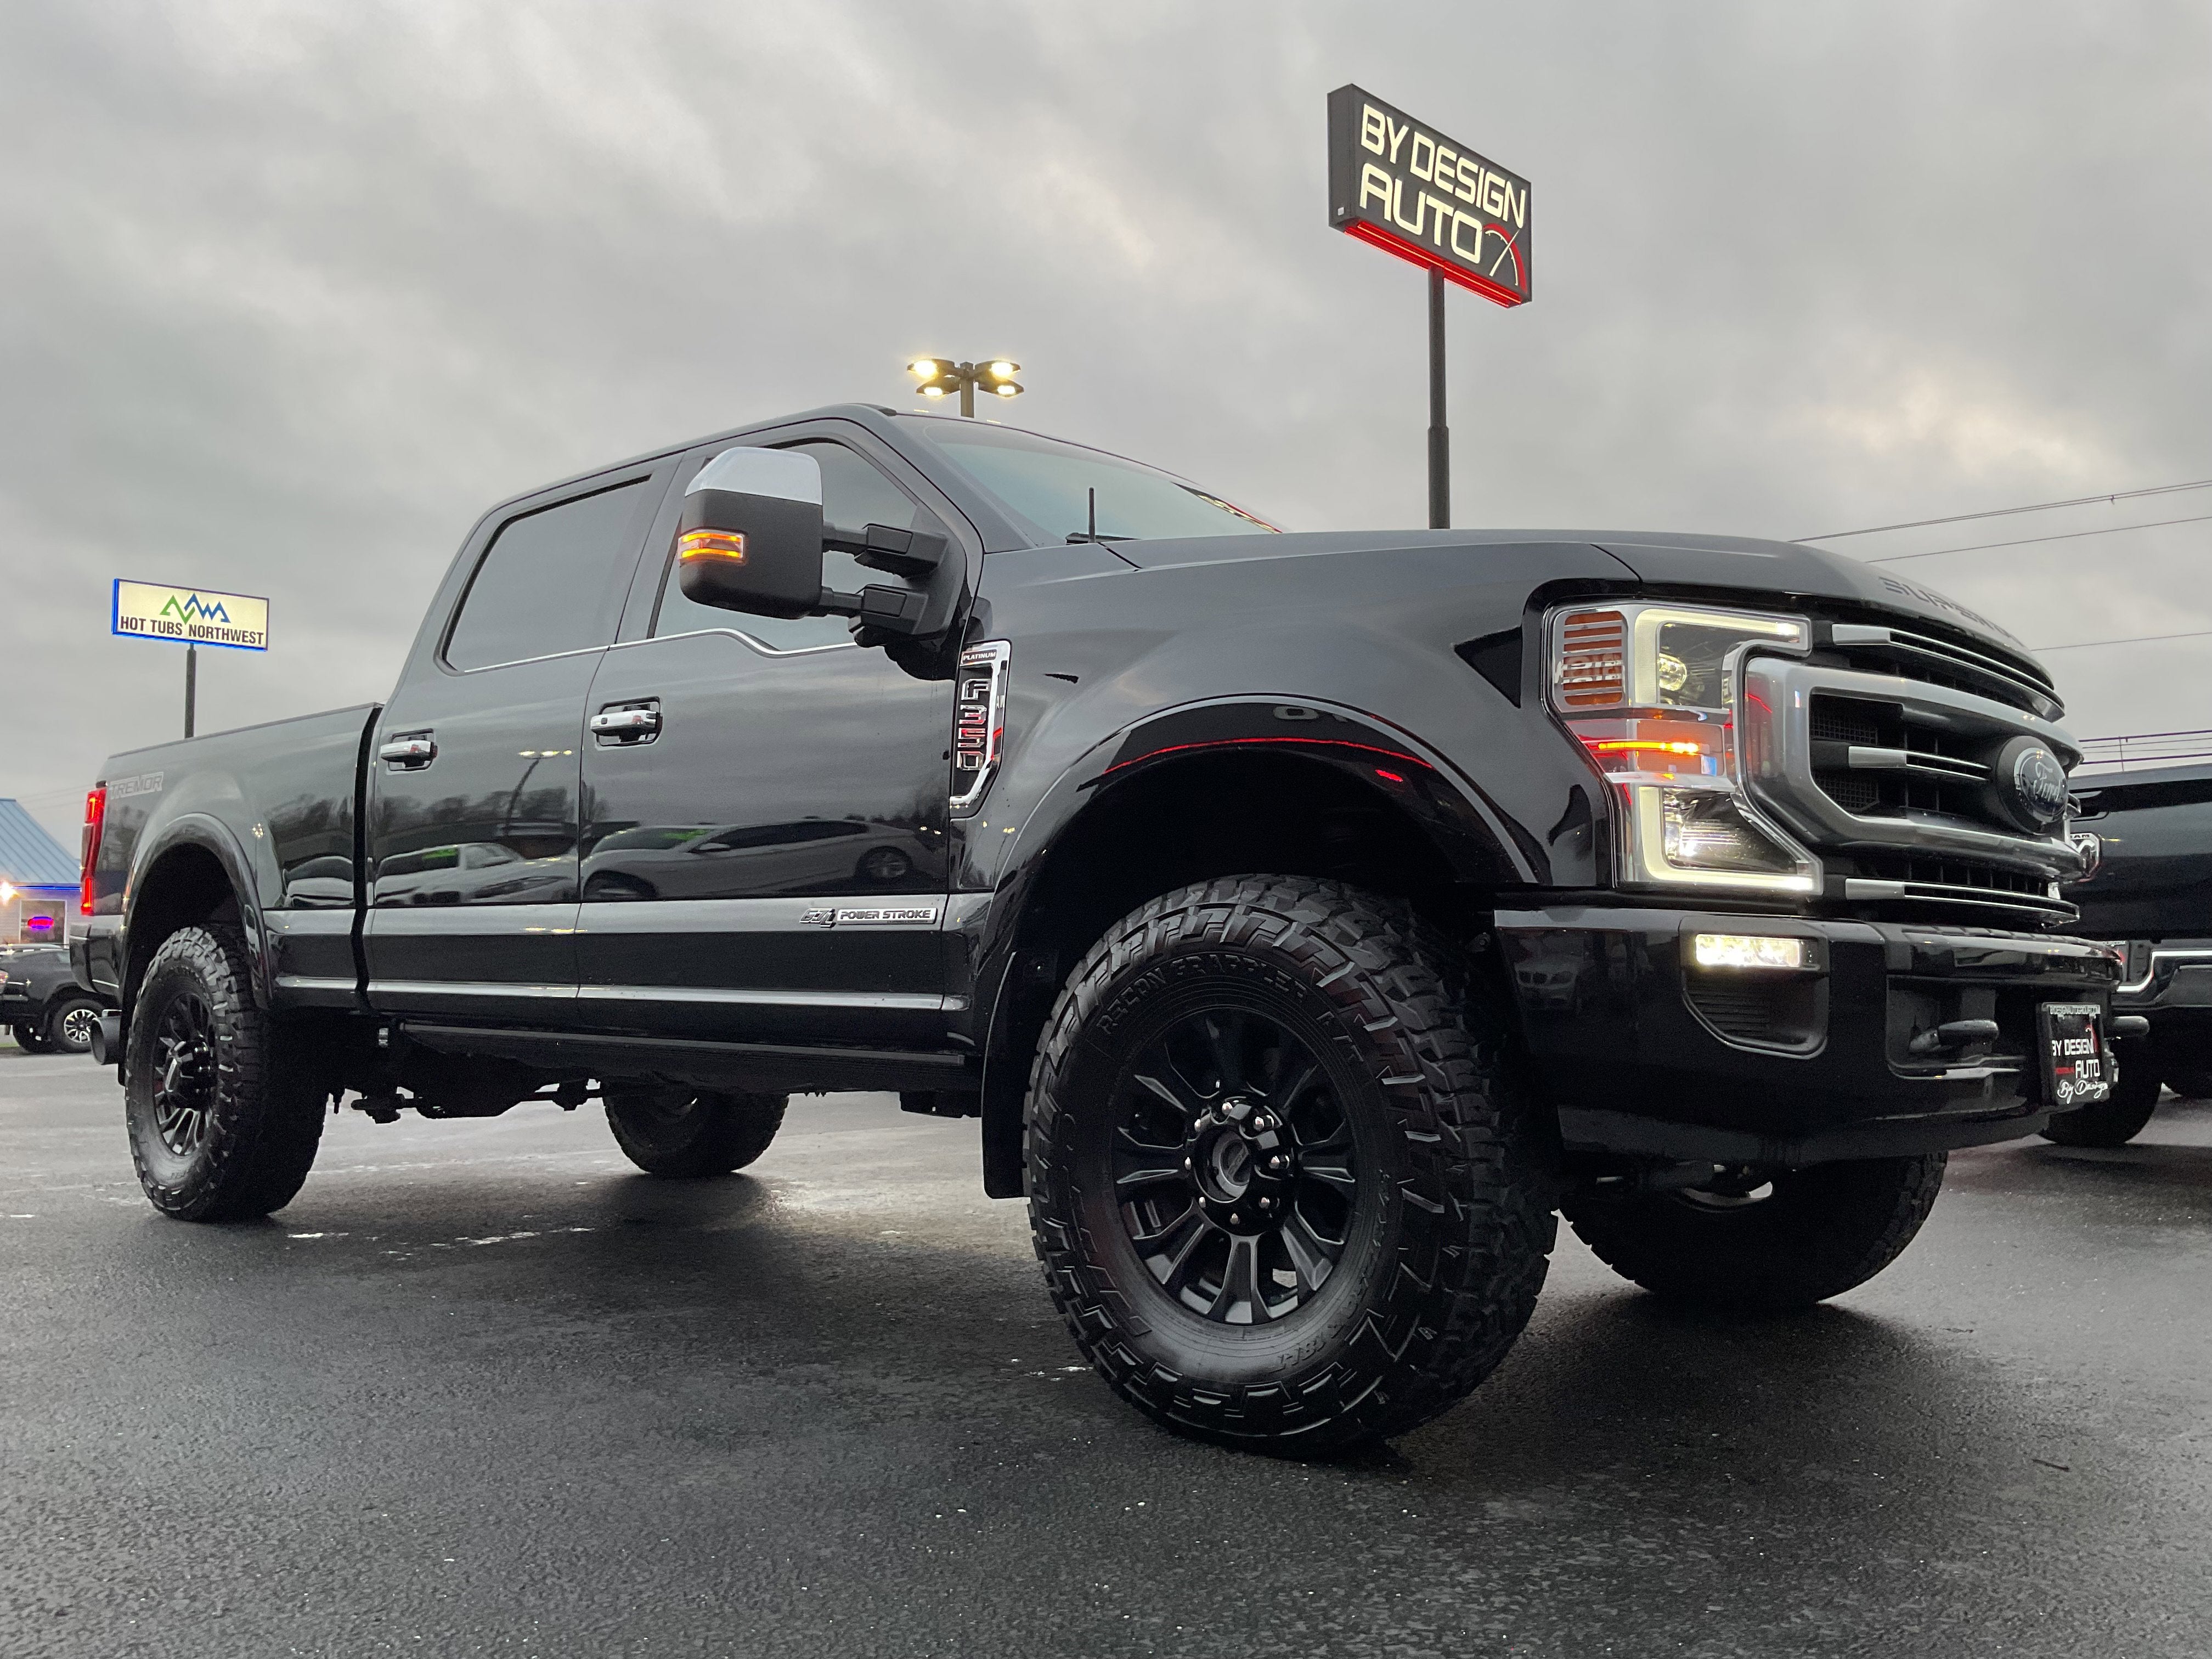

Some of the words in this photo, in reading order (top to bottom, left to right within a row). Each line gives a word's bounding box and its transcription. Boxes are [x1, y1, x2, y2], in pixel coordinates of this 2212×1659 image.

[1361, 103, 1409, 164] BY
[1410, 131, 1526, 229] DESIGN
[1359, 162, 1483, 264] AUTO
[120, 616, 146, 631] HOT
[150, 619, 183, 636] TUBS
[188, 623, 264, 645] NORTHWEST
[962, 651, 997, 661] PLATINUM
[110, 771, 164, 800] TREMOR
[2033, 761, 2062, 803] Ford
[840, 910, 880, 919] POWER
[882, 909, 931, 919] STROKE
[2064, 1039, 2095, 1056] DESIGN
[2075, 1059, 2101, 1079] AUTO
[2057, 1081, 2074, 1104] By
